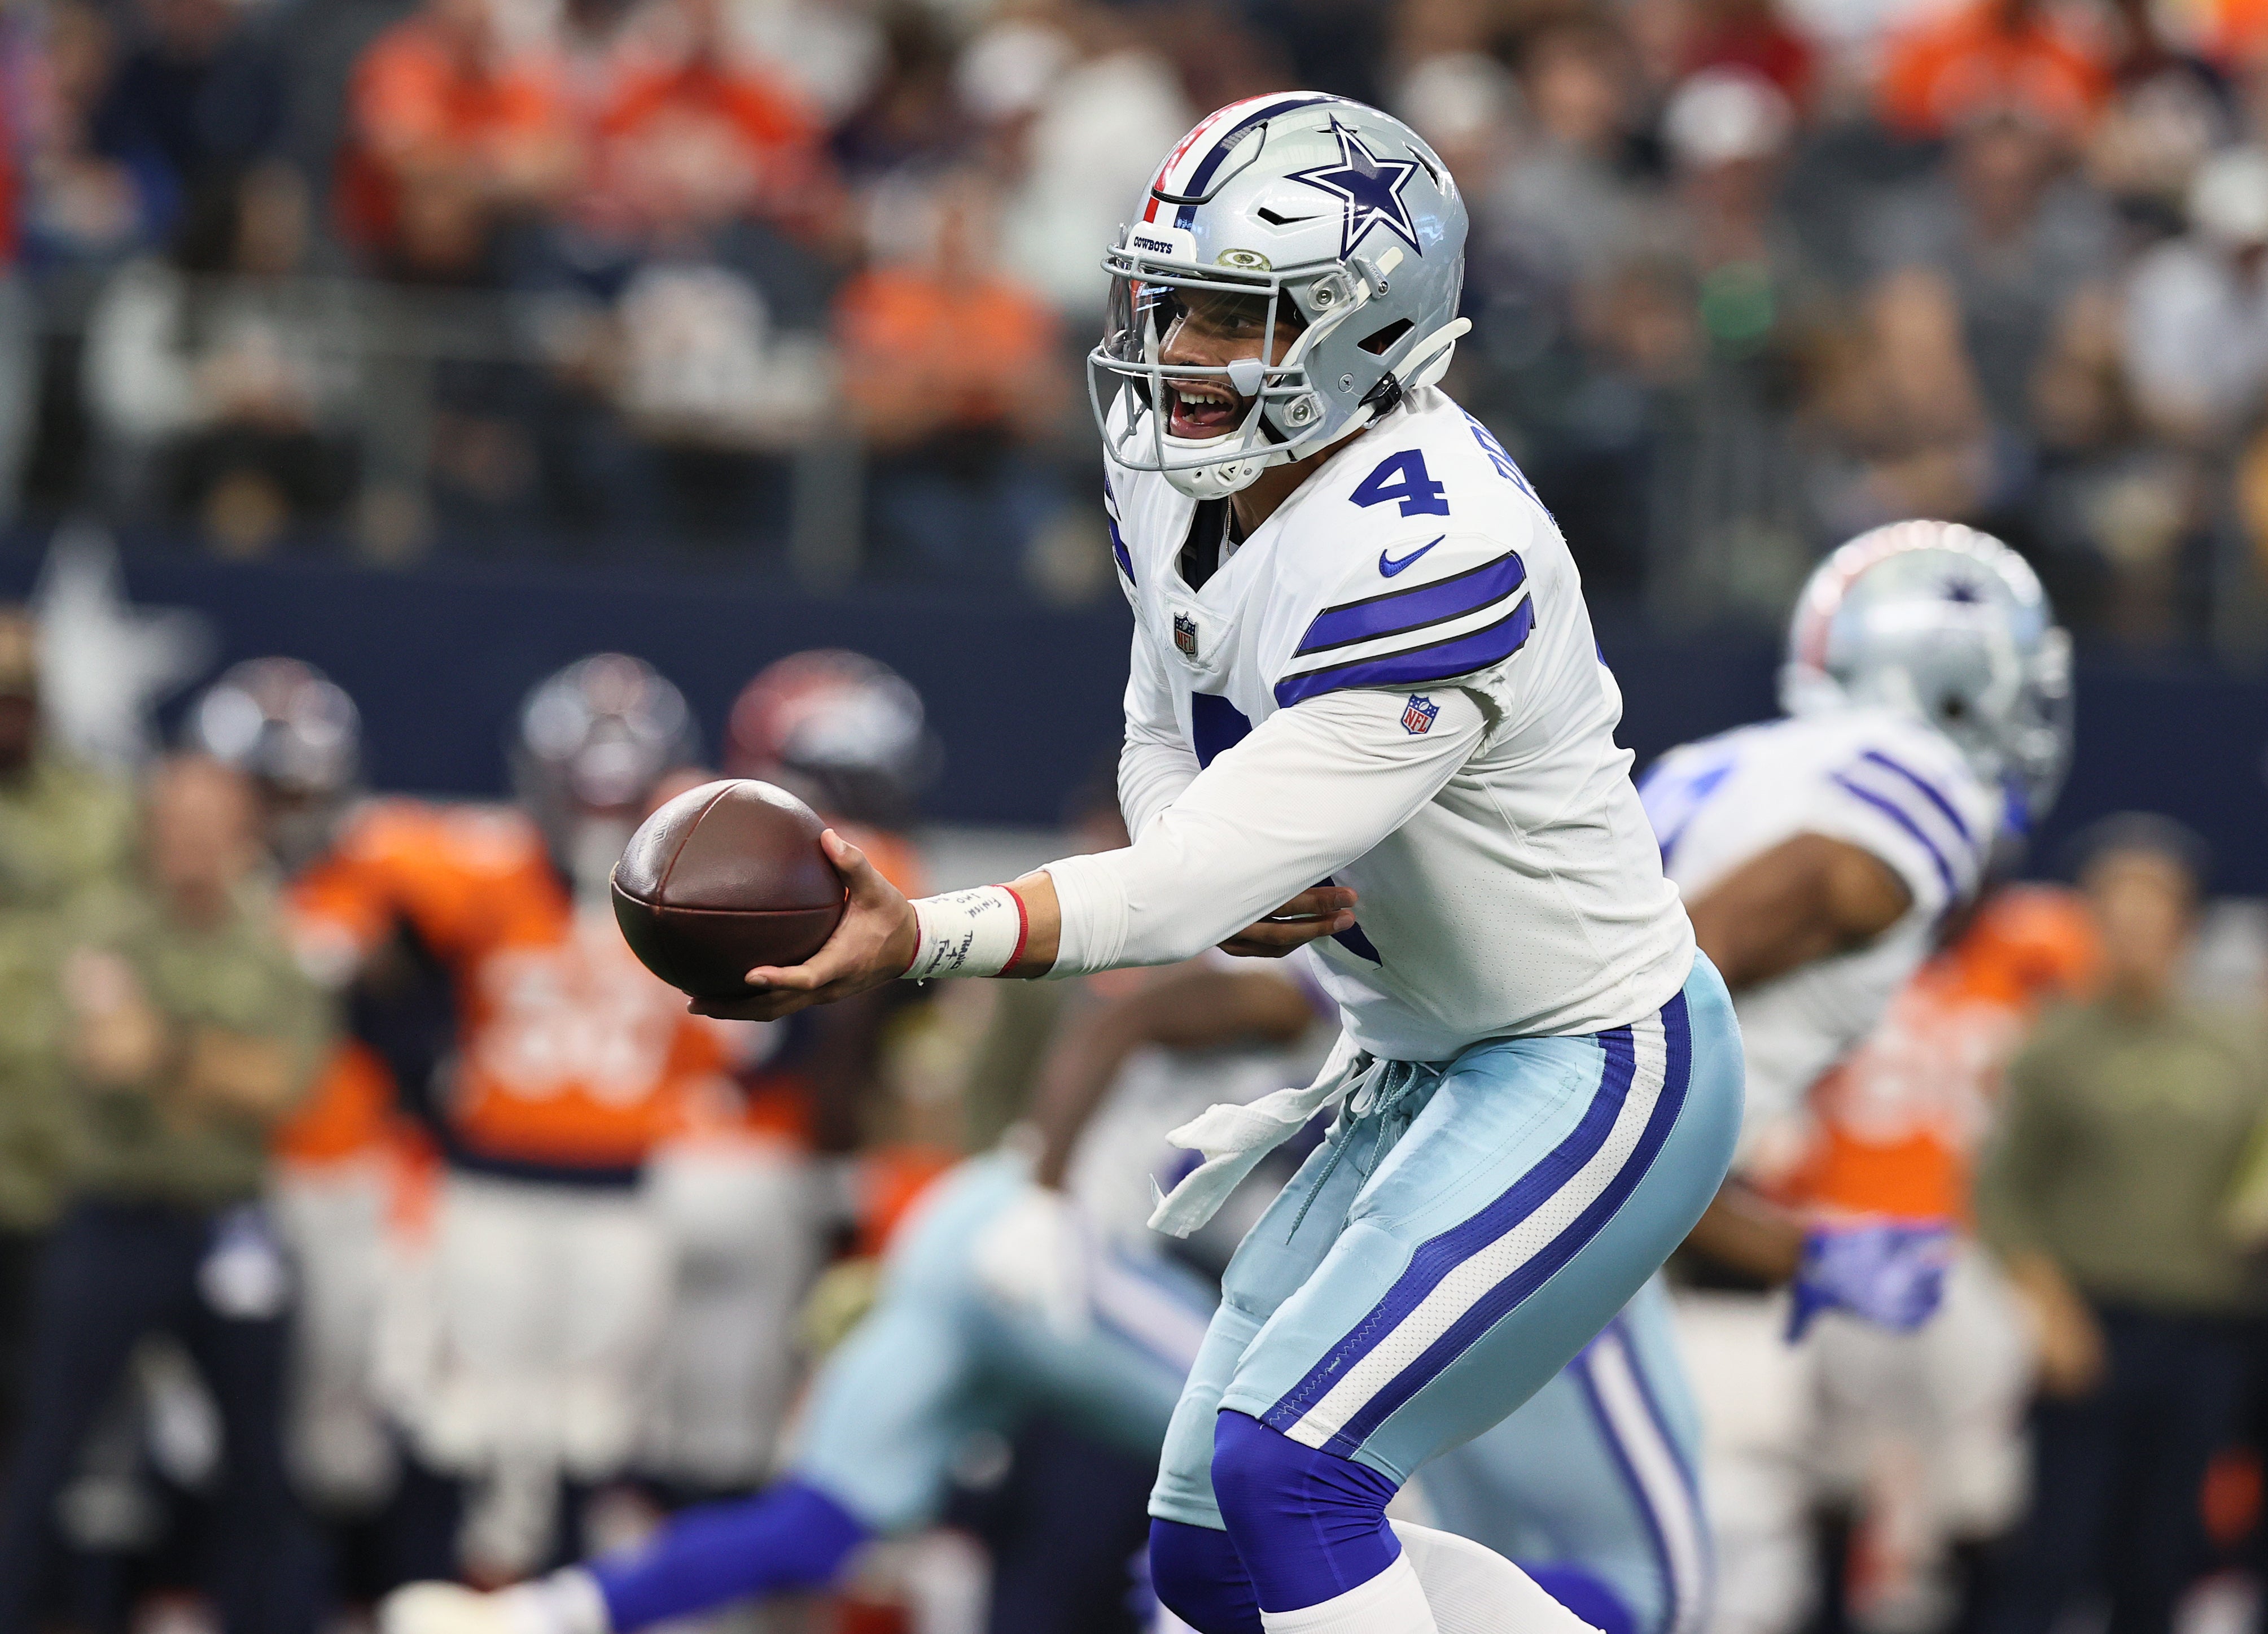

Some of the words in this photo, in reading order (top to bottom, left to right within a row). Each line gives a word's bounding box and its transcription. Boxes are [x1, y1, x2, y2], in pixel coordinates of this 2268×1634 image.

[1133, 236, 1173, 254] COWBOYS
[1349, 449, 1450, 518] 4
[1177, 630, 1193, 651] NFL
[1403, 707, 1429, 732] NFL
